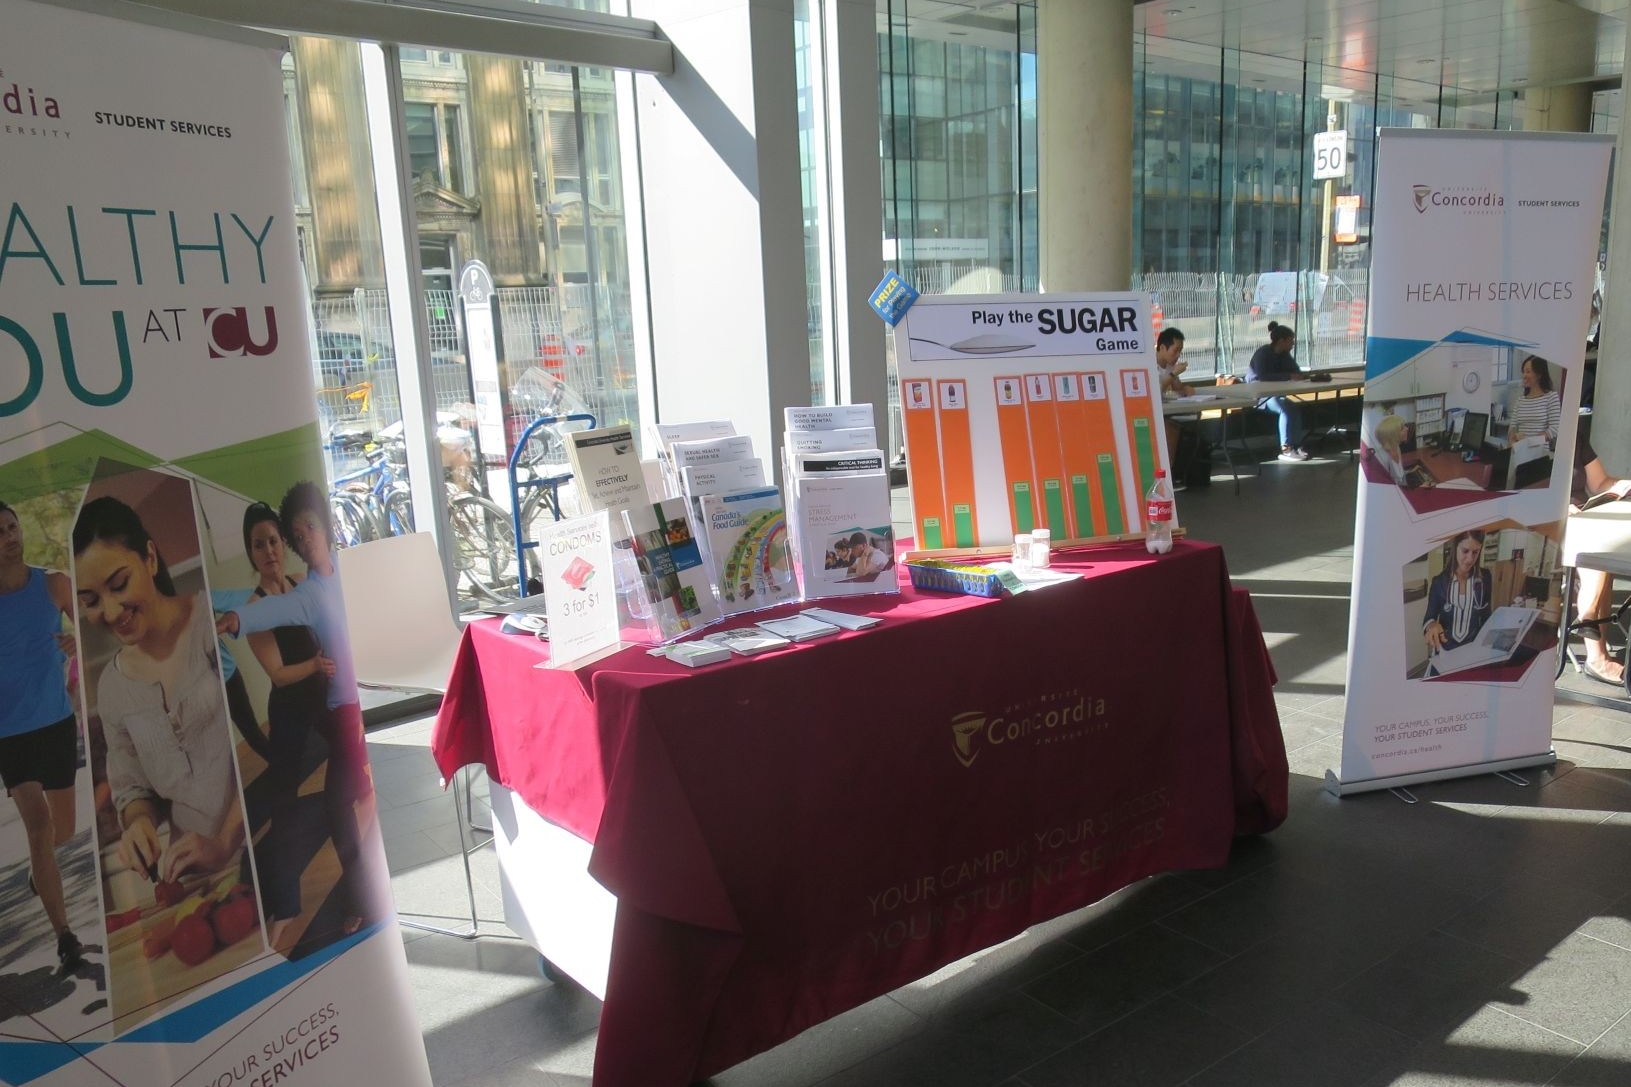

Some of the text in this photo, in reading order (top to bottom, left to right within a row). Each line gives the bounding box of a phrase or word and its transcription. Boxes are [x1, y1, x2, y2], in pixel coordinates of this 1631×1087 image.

[94, 111, 232, 138] STUDENT SERVICES
[1317, 146, 1342, 171] 50
[1431, 191, 1504, 206] Concordia
[1550, 200, 1580, 208] SERVICES
[0, 202, 274, 286] ALTHY
[874, 277, 899, 308] PRIZE
[1406, 281, 1573, 302] HEALTH SERVICES
[143, 308, 187, 343] AT
[202, 306, 279, 359] CU
[971, 307, 1138, 335] Play the SUGAR
[1096, 338, 1139, 352] Game
[595, 474, 629, 488] EFFECTIVELY
[711, 511, 742, 522] Canada's
[713, 518, 749, 530] Food Guide
[808, 508, 831, 516] STRESS
[808, 513, 857, 523] MANAGEMENT
[549, 531, 602, 556] CONDOMS
[563, 602, 571, 617] 3
[572, 599, 587, 614] for
[588, 591, 601, 609] $1
[987, 696, 1105, 745] Concordia
[1375, 722, 1397, 733] YOUR
[1433, 715, 1454, 726] YOUR
[1374, 724, 1468, 743] YOUR STUDENT SERVICES
[1371, 743, 1443, 760] concordia.ca/health
[866, 876, 937, 918] YOUR
[1035, 818, 1094, 852] YOUR
[262, 1002, 340, 1062] SUCCESS,
[250, 1024, 340, 1087] SERVICES
